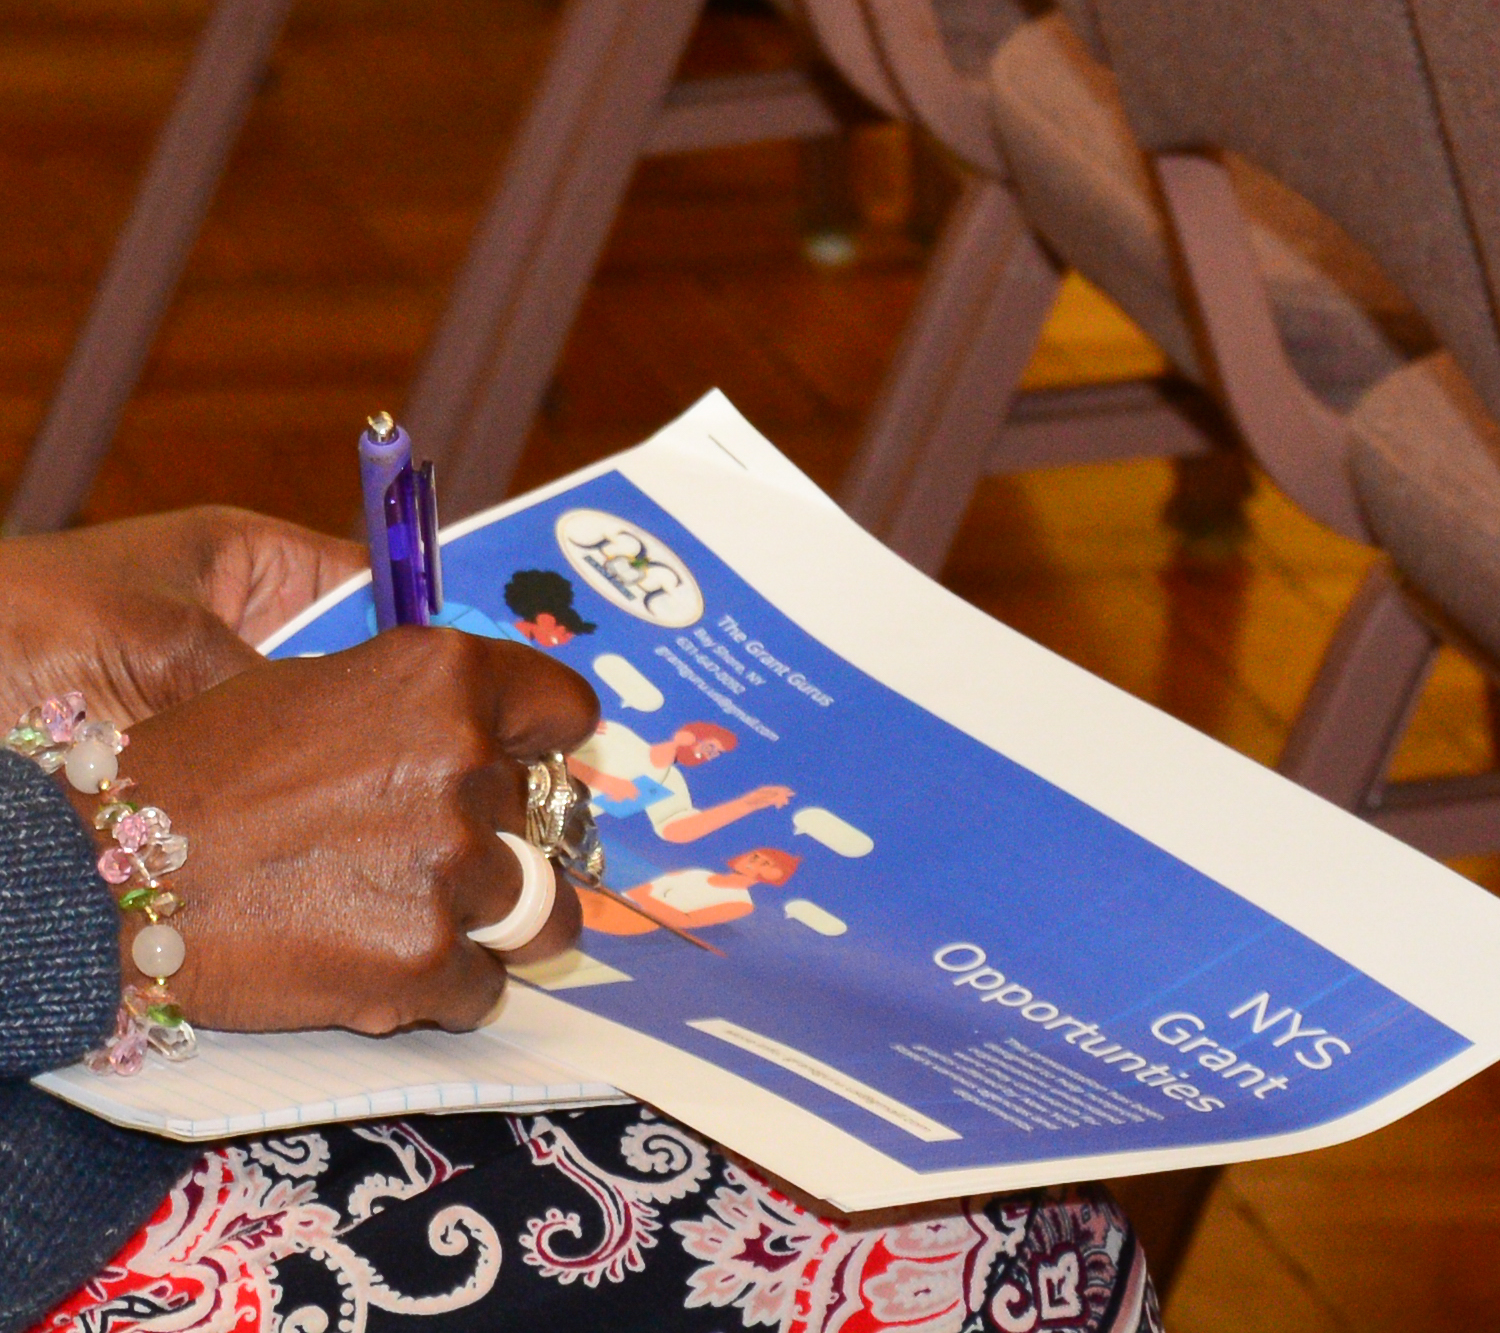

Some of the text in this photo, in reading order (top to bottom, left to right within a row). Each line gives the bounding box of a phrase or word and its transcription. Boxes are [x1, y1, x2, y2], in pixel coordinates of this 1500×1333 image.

[718, 615, 835, 708] The Grant Gurus
[932, 942, 1225, 1113] Opportunties
[1148, 1011, 1289, 1099] Grant
[1228, 990, 1352, 1072] NYS
